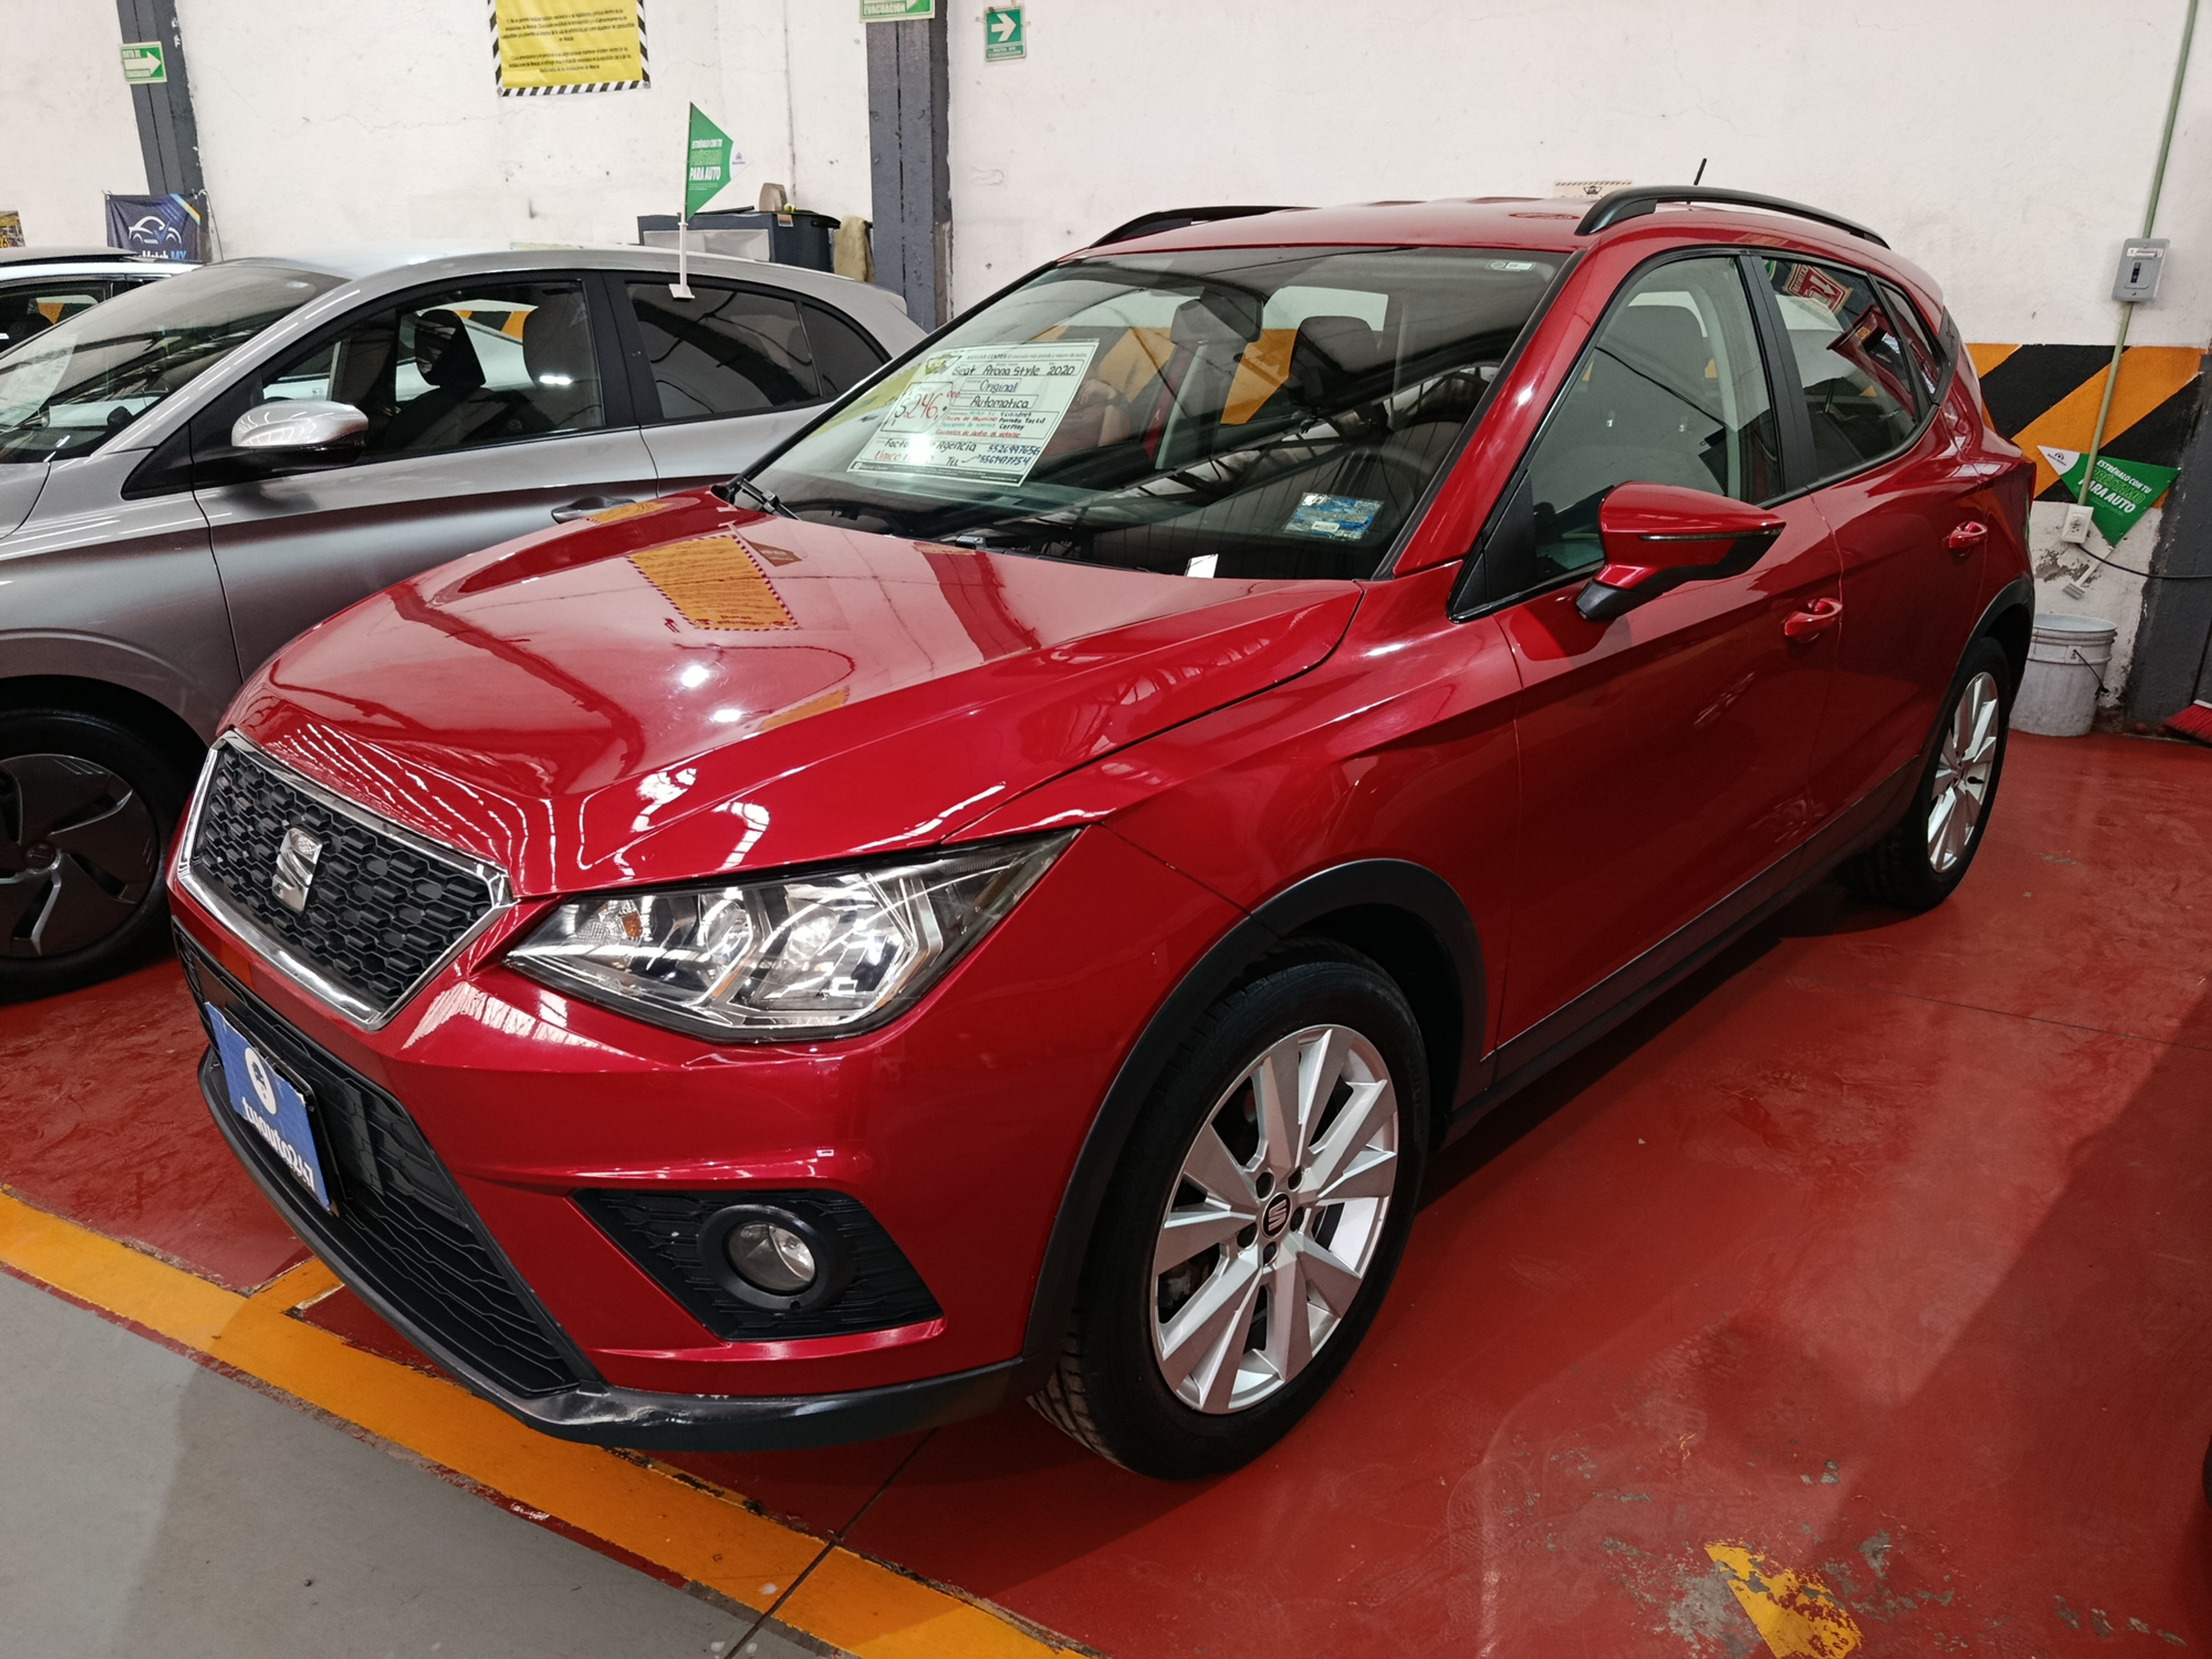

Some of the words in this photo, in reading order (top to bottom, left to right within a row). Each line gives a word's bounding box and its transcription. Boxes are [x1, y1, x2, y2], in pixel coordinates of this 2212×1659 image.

[689, 166, 705, 181] PARA
[705, 166, 721, 181] AUTO
[952, 364, 976, 376] Seat
[982, 364, 1011, 376] Arona
[1013, 364, 1040, 376] Style
[1046, 366, 1076, 376] 2020
[980, 379, 1018, 393] Original
[970, 395, 1029, 409] Automatica
[936, 441, 977, 452] Agencia
[2097, 460, 2130, 482] ESTRÉNALO
[2128, 478, 2144, 489] CON
[2141, 484, 2152, 494] TU
[2104, 492, 2136, 513] AUTO
